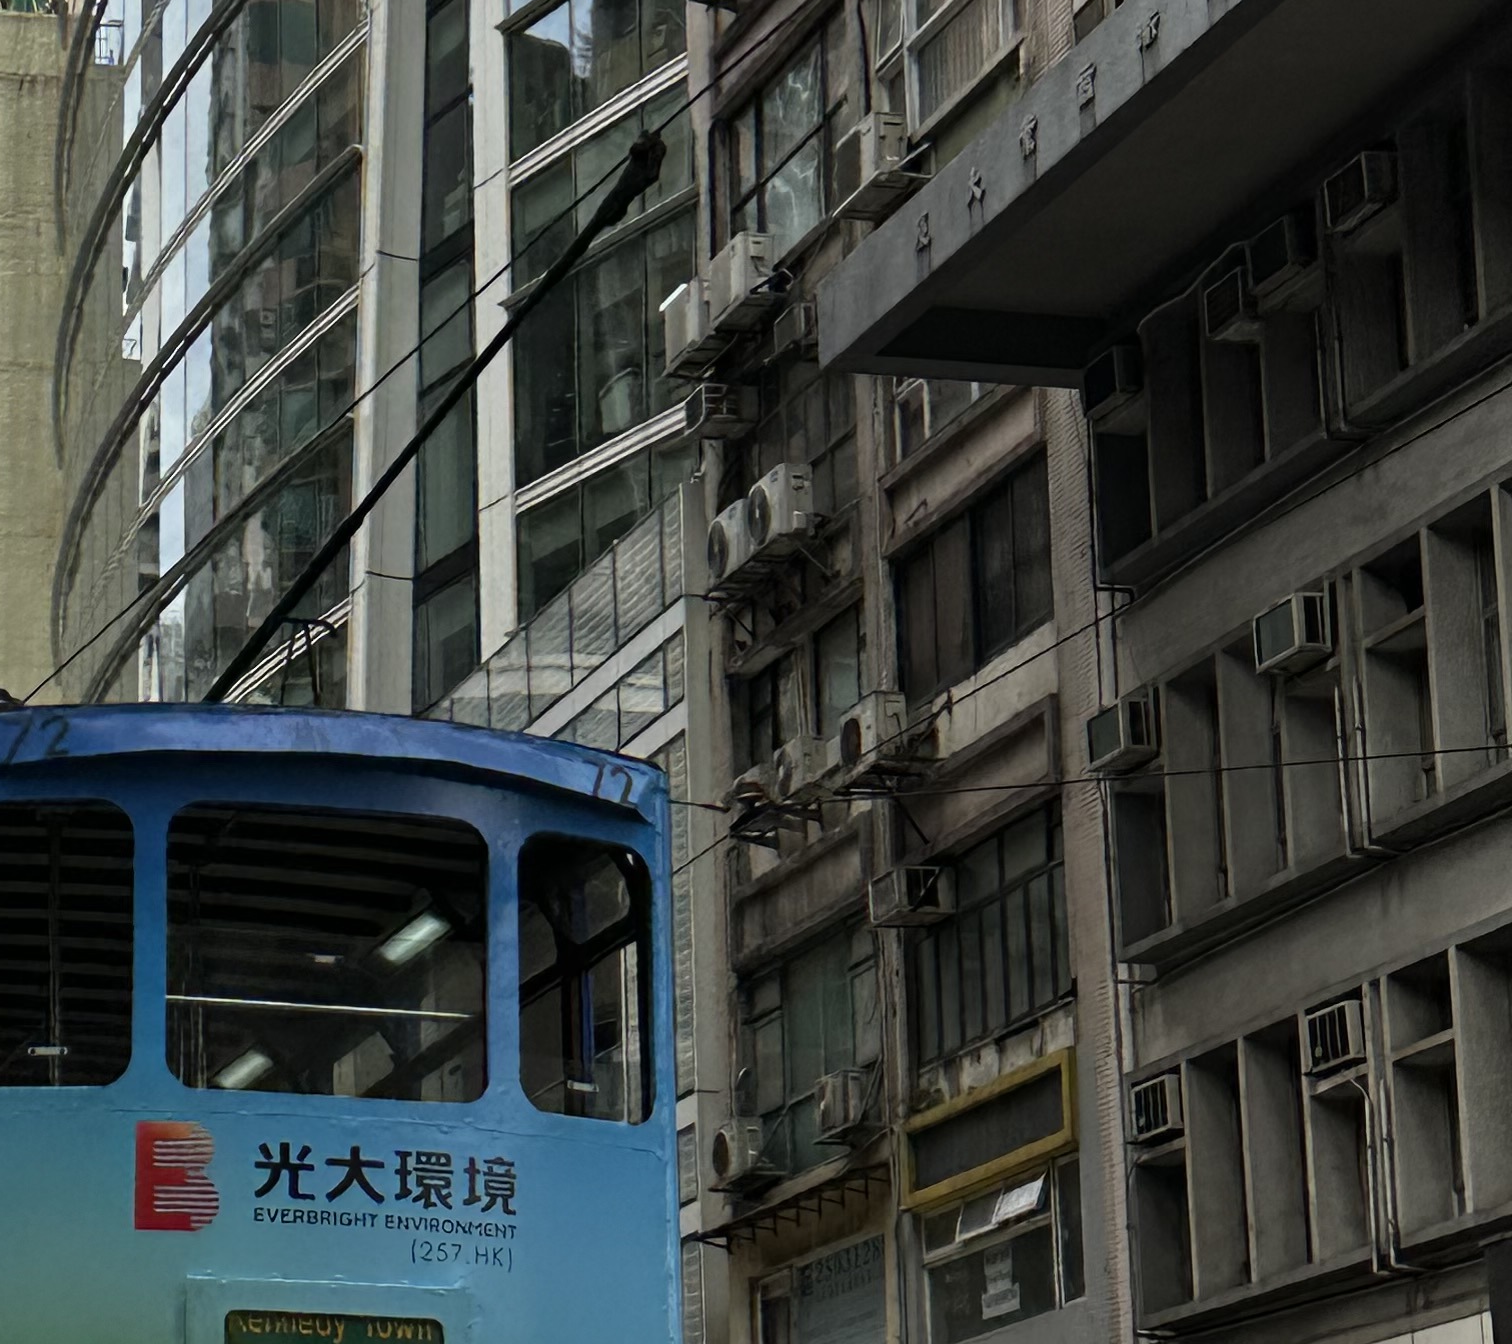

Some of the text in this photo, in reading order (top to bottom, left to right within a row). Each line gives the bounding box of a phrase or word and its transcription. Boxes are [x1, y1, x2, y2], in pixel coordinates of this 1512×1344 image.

[254, 1141, 517, 1216] 光大環境
[253, 1206, 517, 1240] EVERBRIGHT ENVIRONMENT
